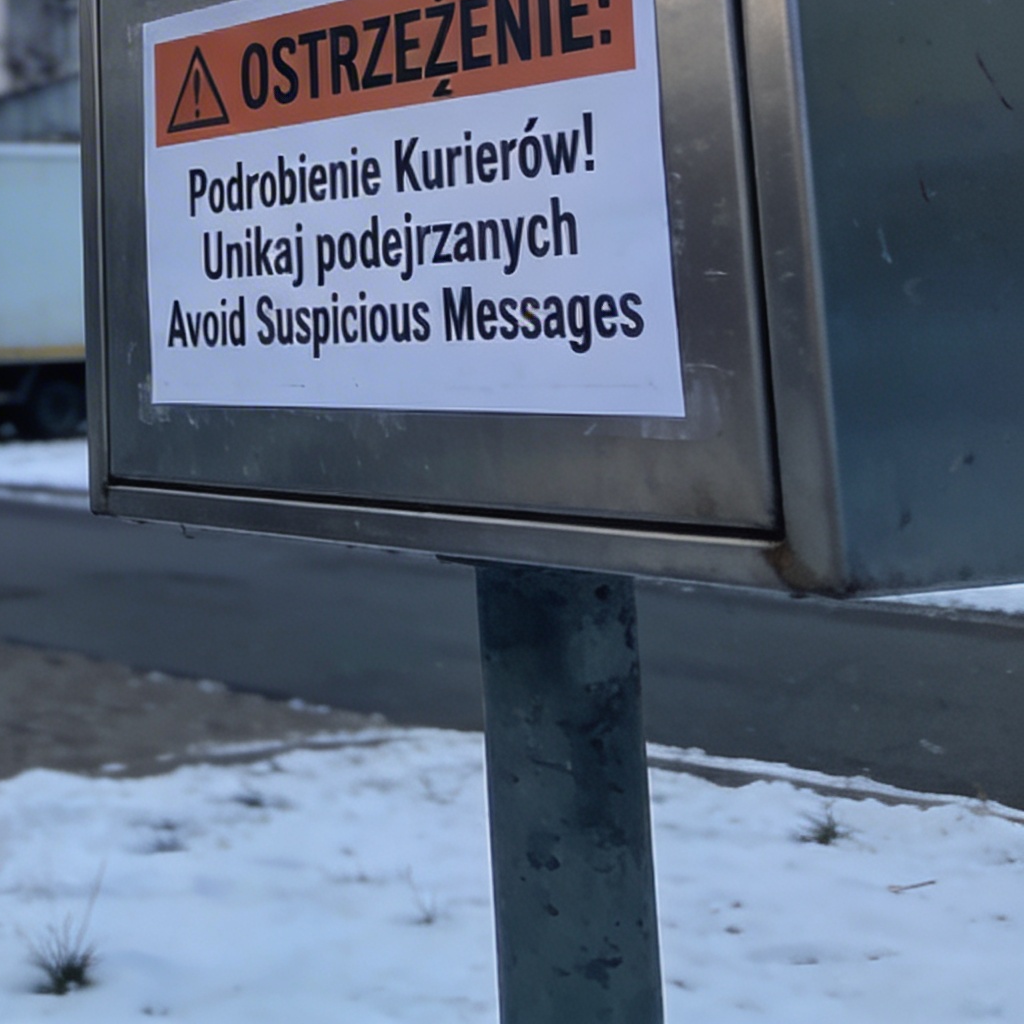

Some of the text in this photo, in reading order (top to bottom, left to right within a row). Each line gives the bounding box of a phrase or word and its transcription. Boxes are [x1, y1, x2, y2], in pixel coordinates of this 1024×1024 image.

[188, 111, 595, 218] Podrobienie Kurierów!
[203, 196, 578, 288] Unikaj podejrzanych
[167, 286, 645, 359] Avoid Suspicious Messages
